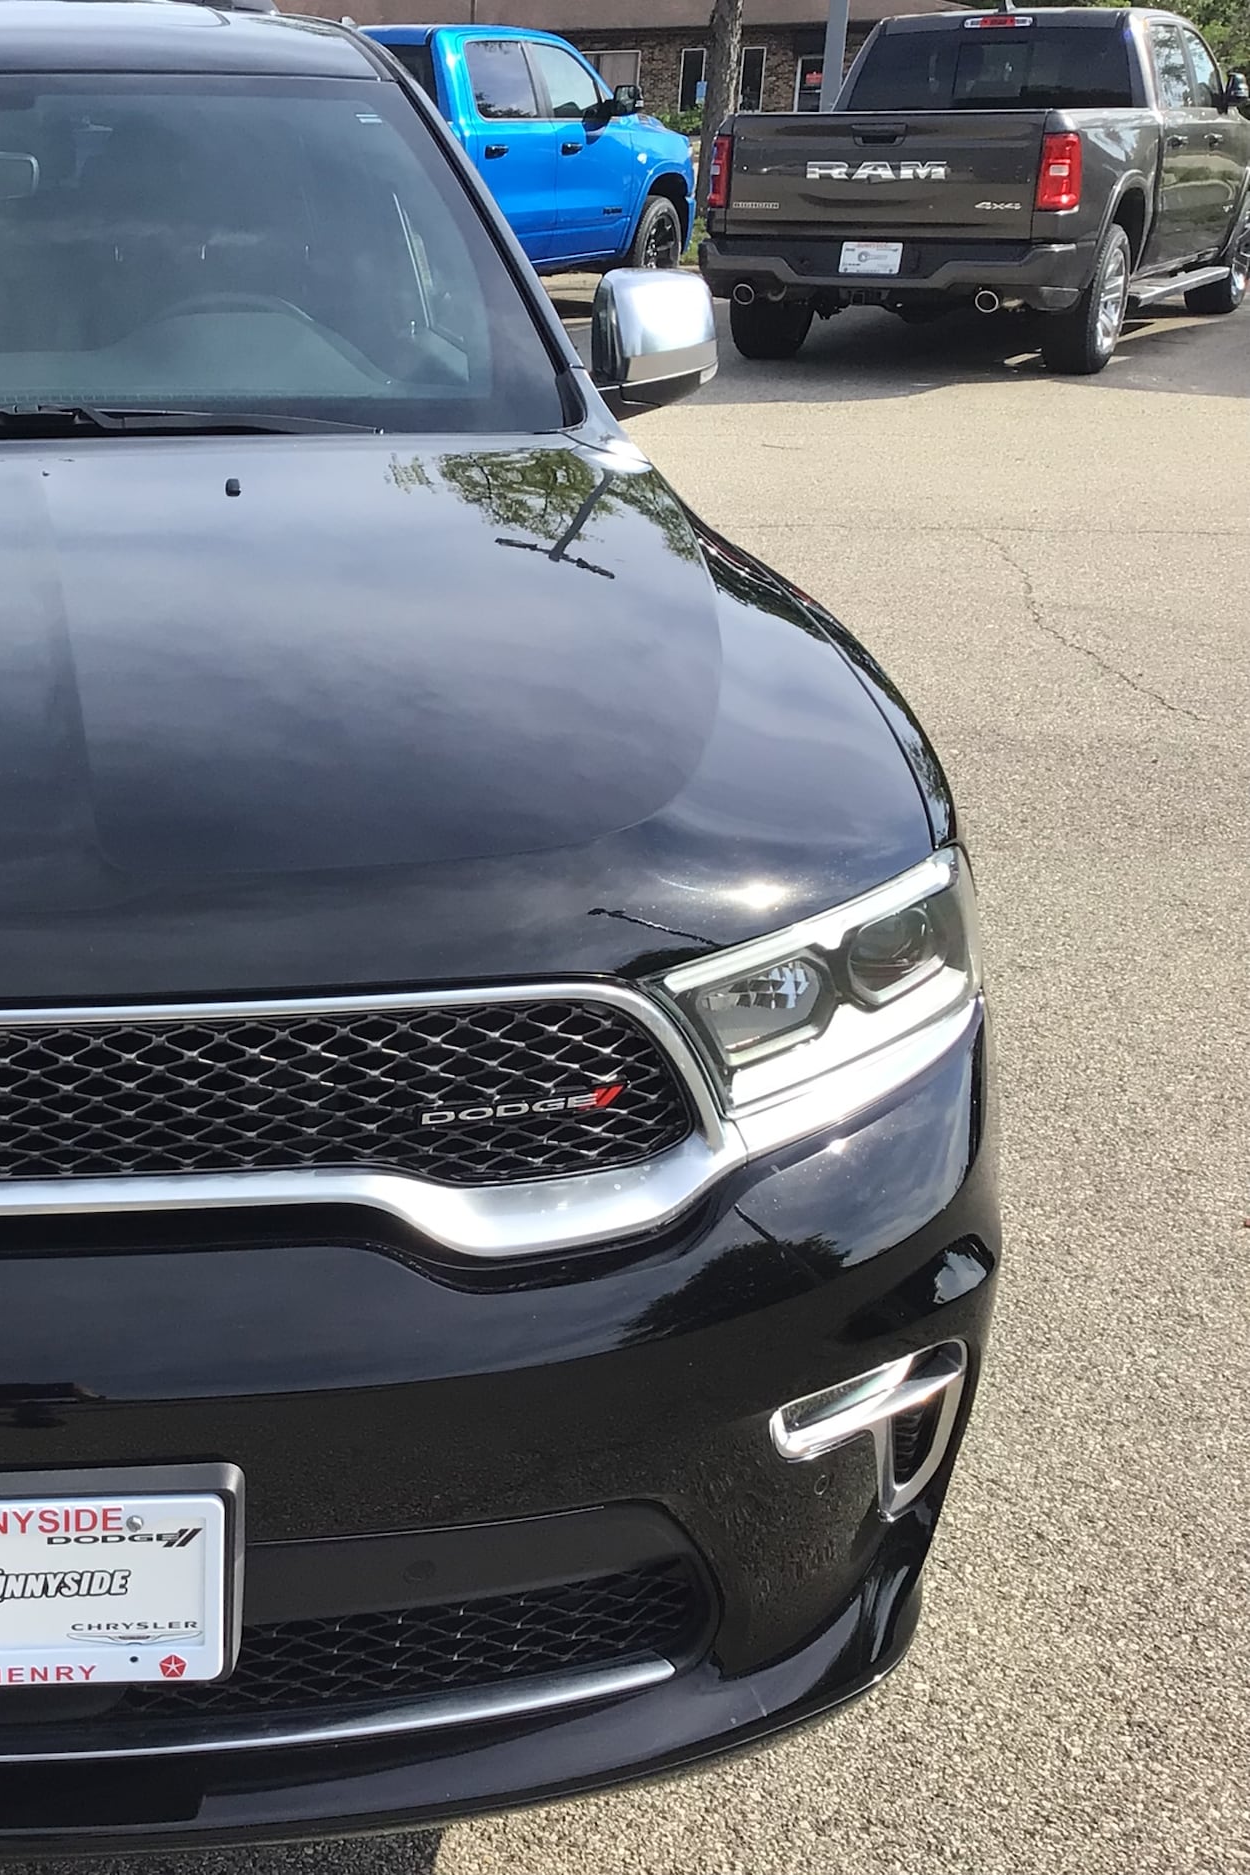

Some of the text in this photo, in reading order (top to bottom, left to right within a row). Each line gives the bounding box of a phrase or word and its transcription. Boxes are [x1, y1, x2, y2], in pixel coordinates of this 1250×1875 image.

[806, 161, 948, 180] RAM
[420, 1092, 599, 1126] DODGE
[46, 1532, 180, 1547] DODGE
[70, 1620, 199, 1632] CHRYSLER
